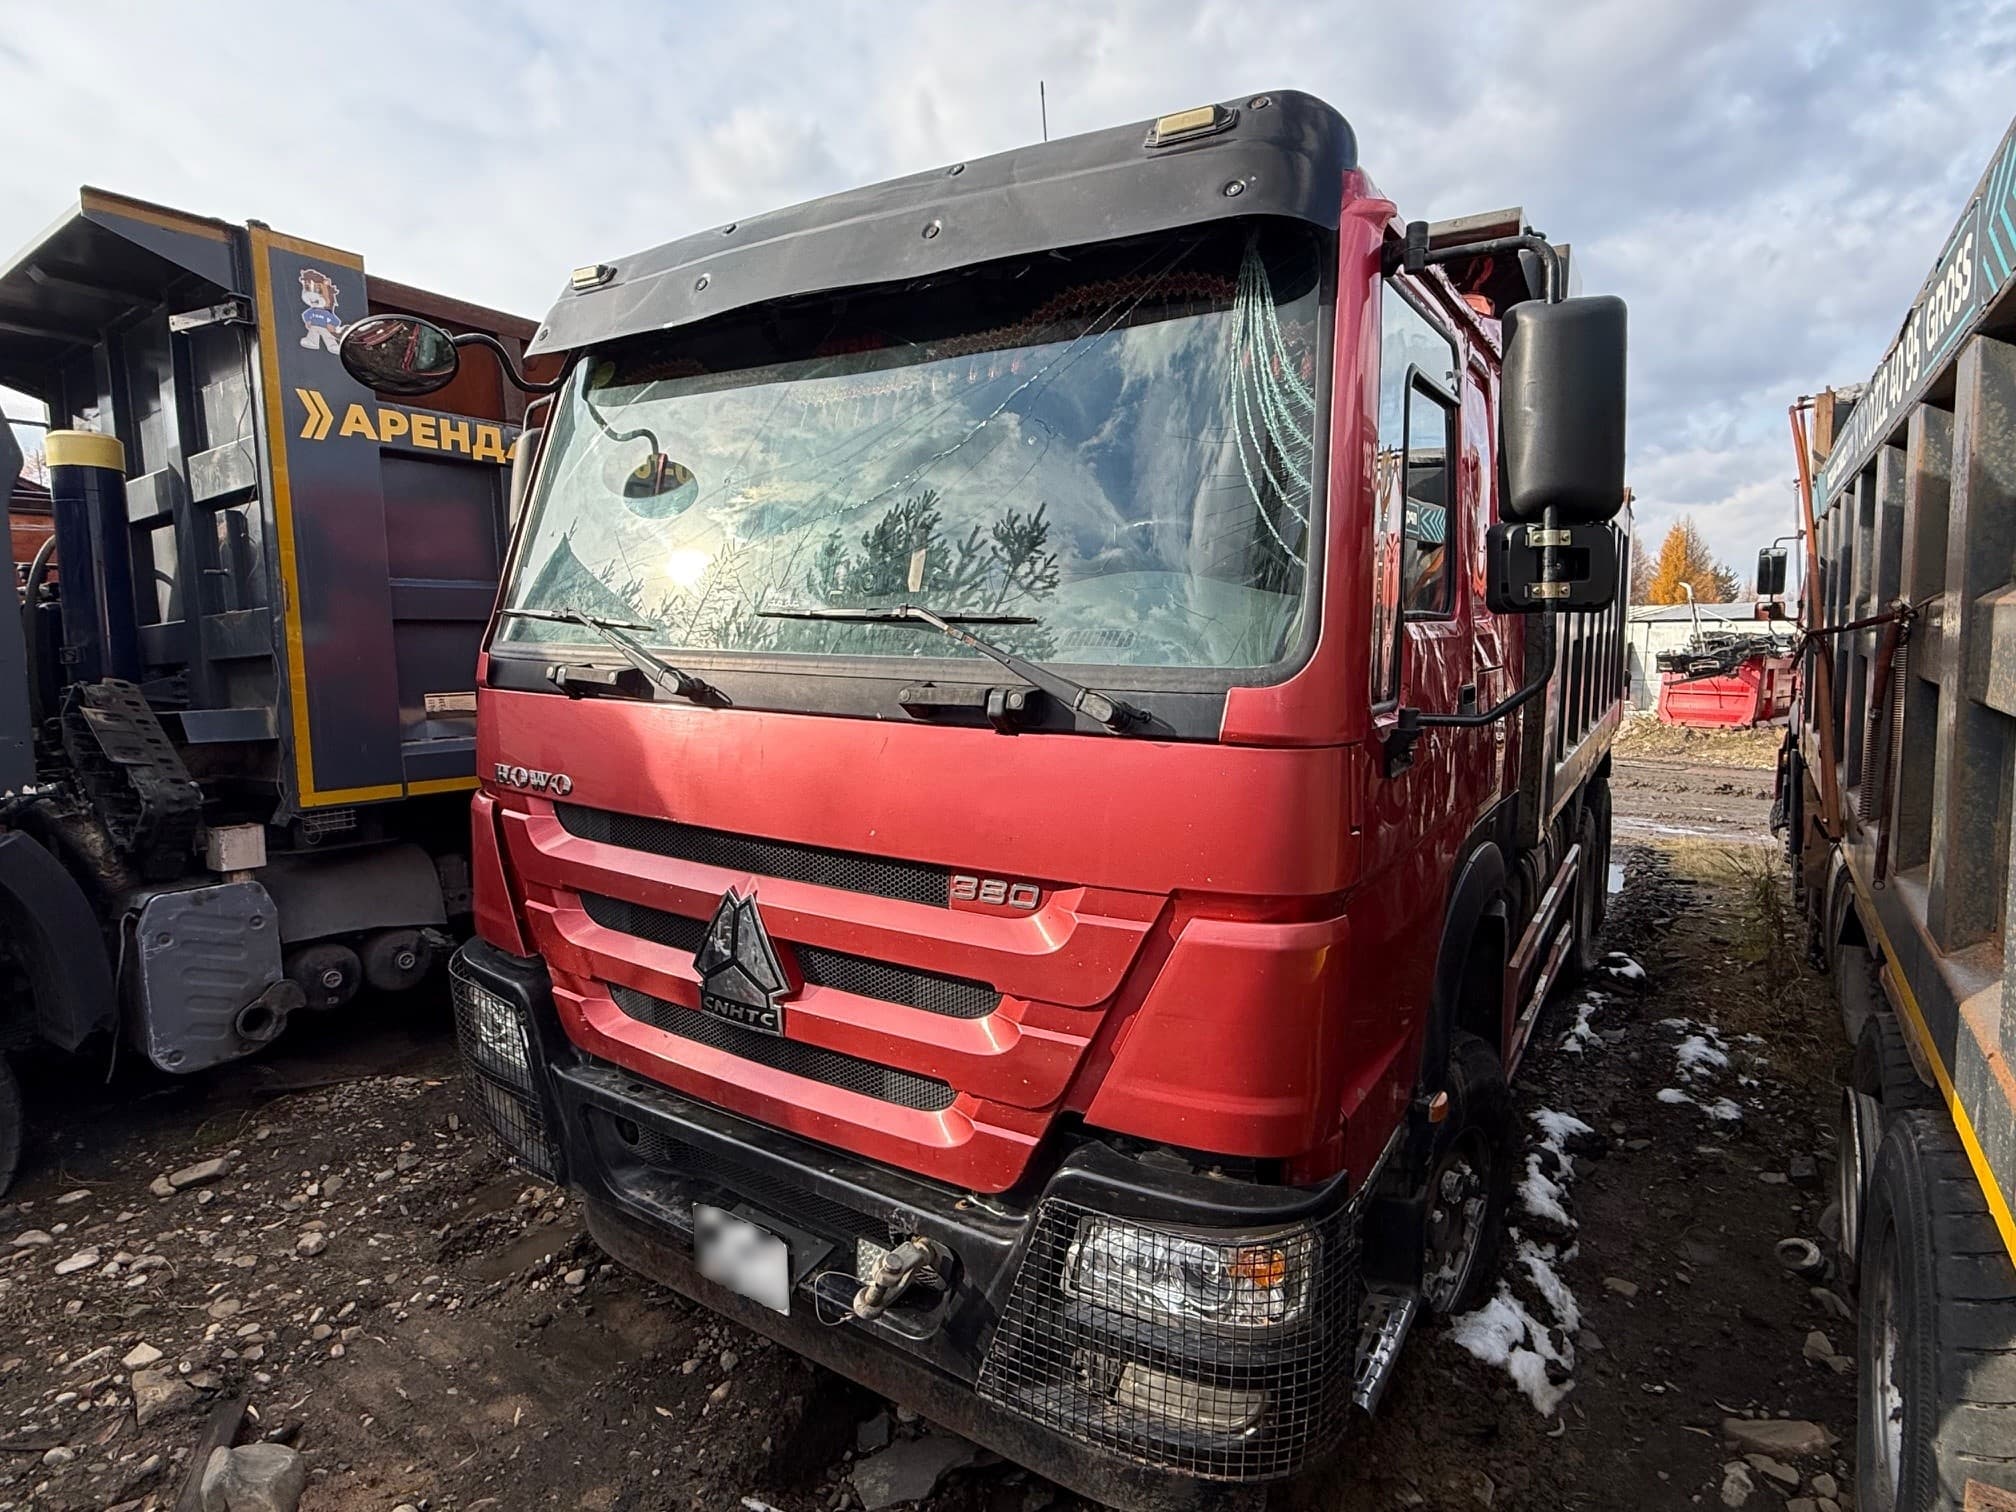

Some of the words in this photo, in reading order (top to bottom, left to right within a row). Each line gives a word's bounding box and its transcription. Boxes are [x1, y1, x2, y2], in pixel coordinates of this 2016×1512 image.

[1926, 232, 1973, 352] GROSS
[1905, 310, 1920, 391] 95
[495, 763, 572, 796] HOWO
[952, 874, 1040, 910] 380
[703, 996, 776, 1027] CNHTC
